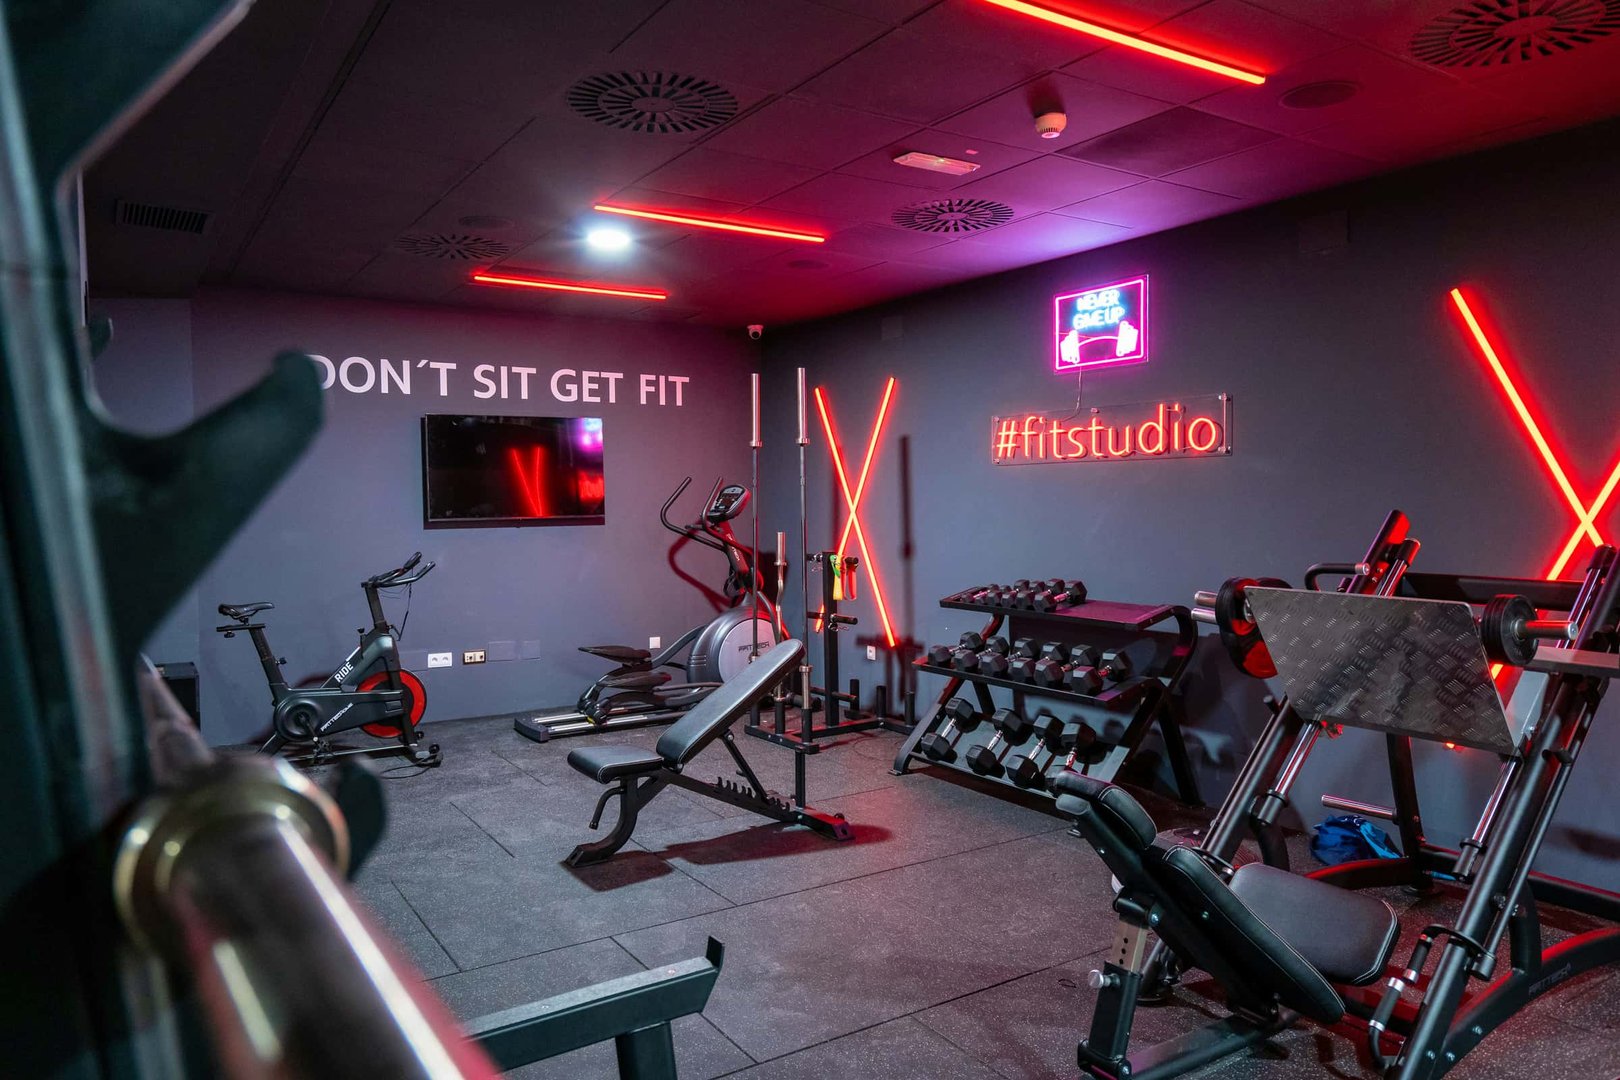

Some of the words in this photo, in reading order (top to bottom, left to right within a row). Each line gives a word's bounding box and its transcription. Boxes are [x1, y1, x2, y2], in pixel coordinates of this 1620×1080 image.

[1076, 289, 1120, 311] NEVER
[1073, 309, 1105, 330] GIVE
[1104, 306, 1125, 324] UP
[473, 364, 537, 400] SIT
[550, 368, 624, 403] GET
[639, 373, 690, 406] FIT
[996, 403, 1217, 459] #fitstudio
[334, 661, 354, 684] RIDE
